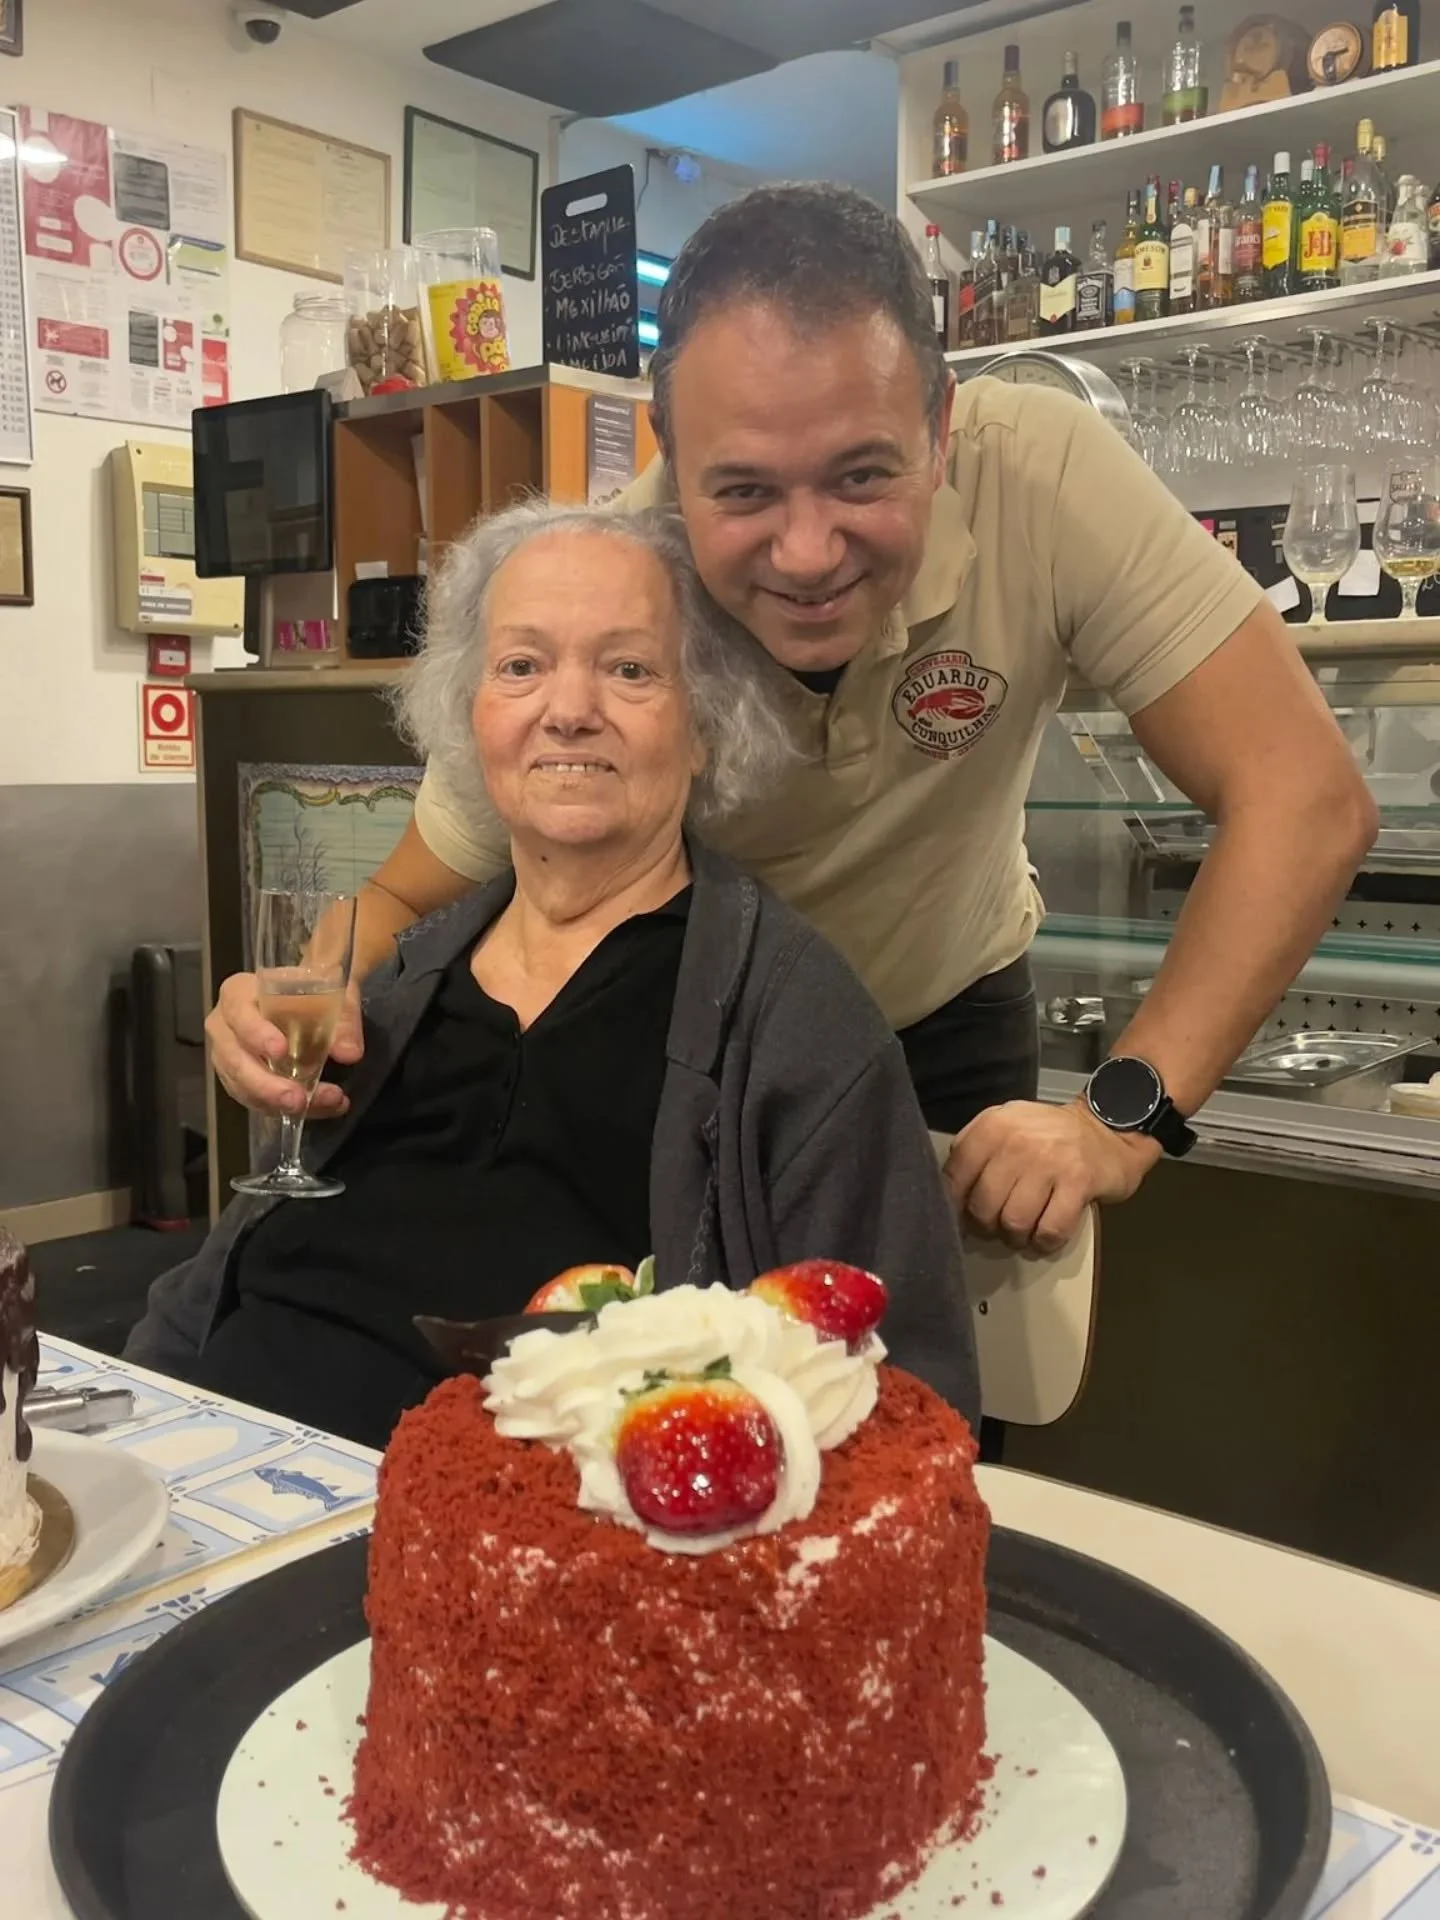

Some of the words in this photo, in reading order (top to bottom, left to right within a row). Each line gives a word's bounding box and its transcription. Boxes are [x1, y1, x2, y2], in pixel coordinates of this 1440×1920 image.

[1136, 245, 1166, 255] AMESON
[902, 669, 989, 704] EDUARDO
[911, 704, 996, 747] CONQUILHAS
